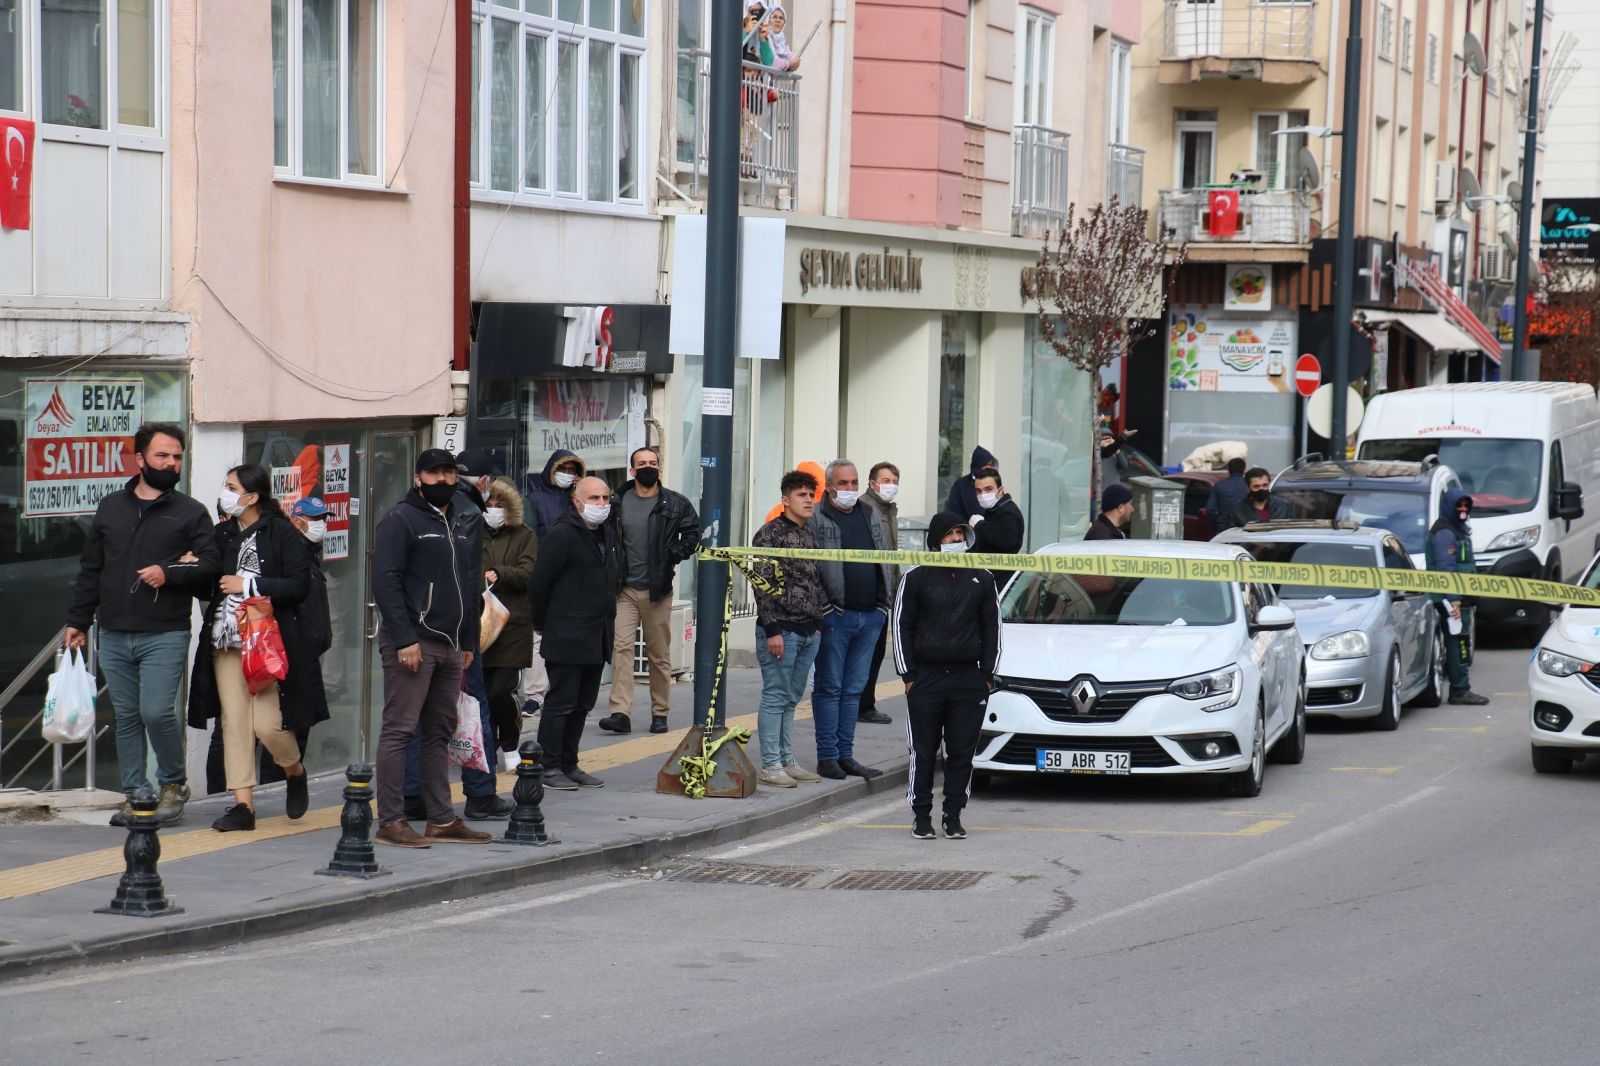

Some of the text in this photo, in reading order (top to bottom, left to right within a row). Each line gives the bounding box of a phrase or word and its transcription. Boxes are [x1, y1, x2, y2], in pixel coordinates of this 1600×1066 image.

[82, 385, 136, 411] BEYAZ
[37, 422, 60, 435] beyaz
[87, 415, 111, 432] EMLAK
[541, 427, 616, 452] TaS Accessories
[42, 441, 125, 475] SATILIK
[273, 469, 301, 494] KİRALIK
[325, 468, 347, 483] BEYAZ
[326, 502, 348, 522] ATILIK
[1045, 752, 1128, 769] 58 ABR 512
